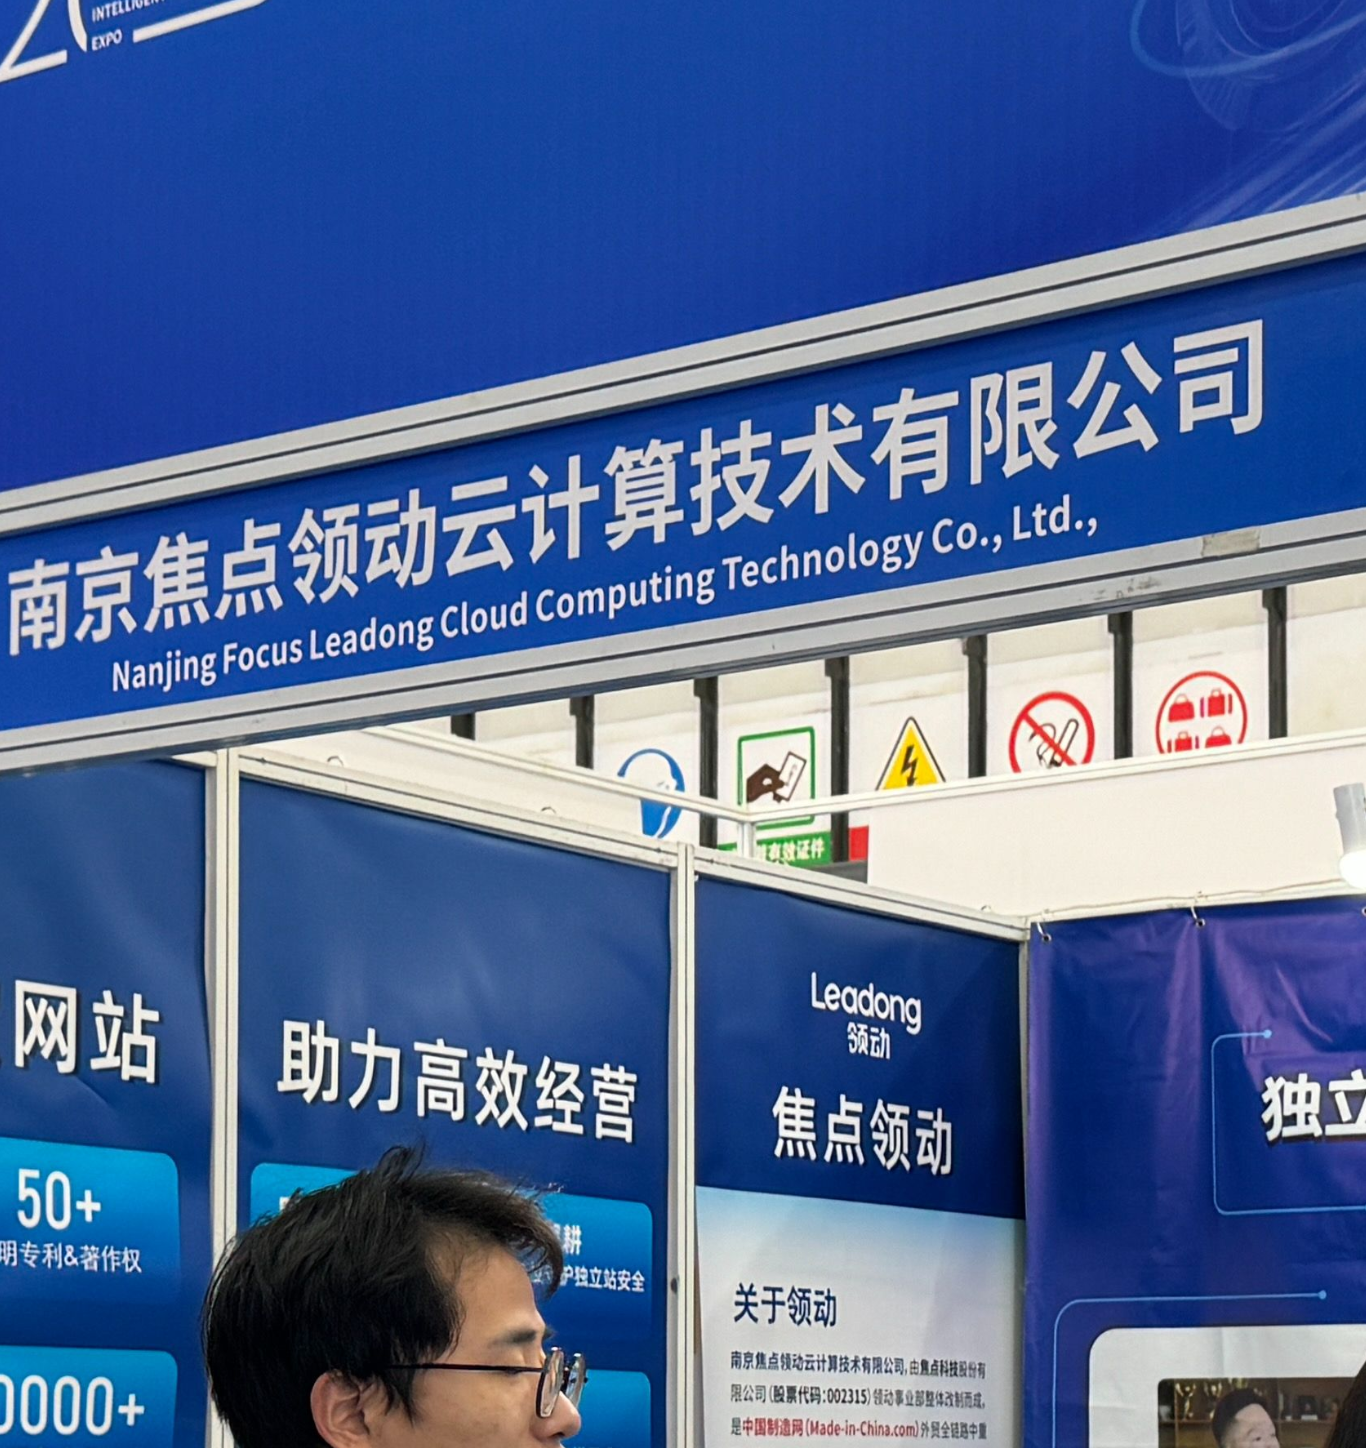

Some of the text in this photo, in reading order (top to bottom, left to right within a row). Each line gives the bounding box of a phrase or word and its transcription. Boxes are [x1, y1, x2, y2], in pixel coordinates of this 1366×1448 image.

[91, 29, 123, 51] EXPO
[8, 319, 1265, 656] 南京焦点领动云计算技术有限公司
[111, 494, 1099, 693] Nanjing Focus Leadong Cloud Computing Technology Co., Ltd.,
[811, 971, 923, 1036] Leadong
[847, 1021, 891, 1060] 领动
[277, 1018, 638, 1144] 助力高效经营
[772, 1085, 953, 1176] 焦点领动
[16, 1168, 103, 1231] 50+
[733, 1282, 838, 1328] 关于领动
